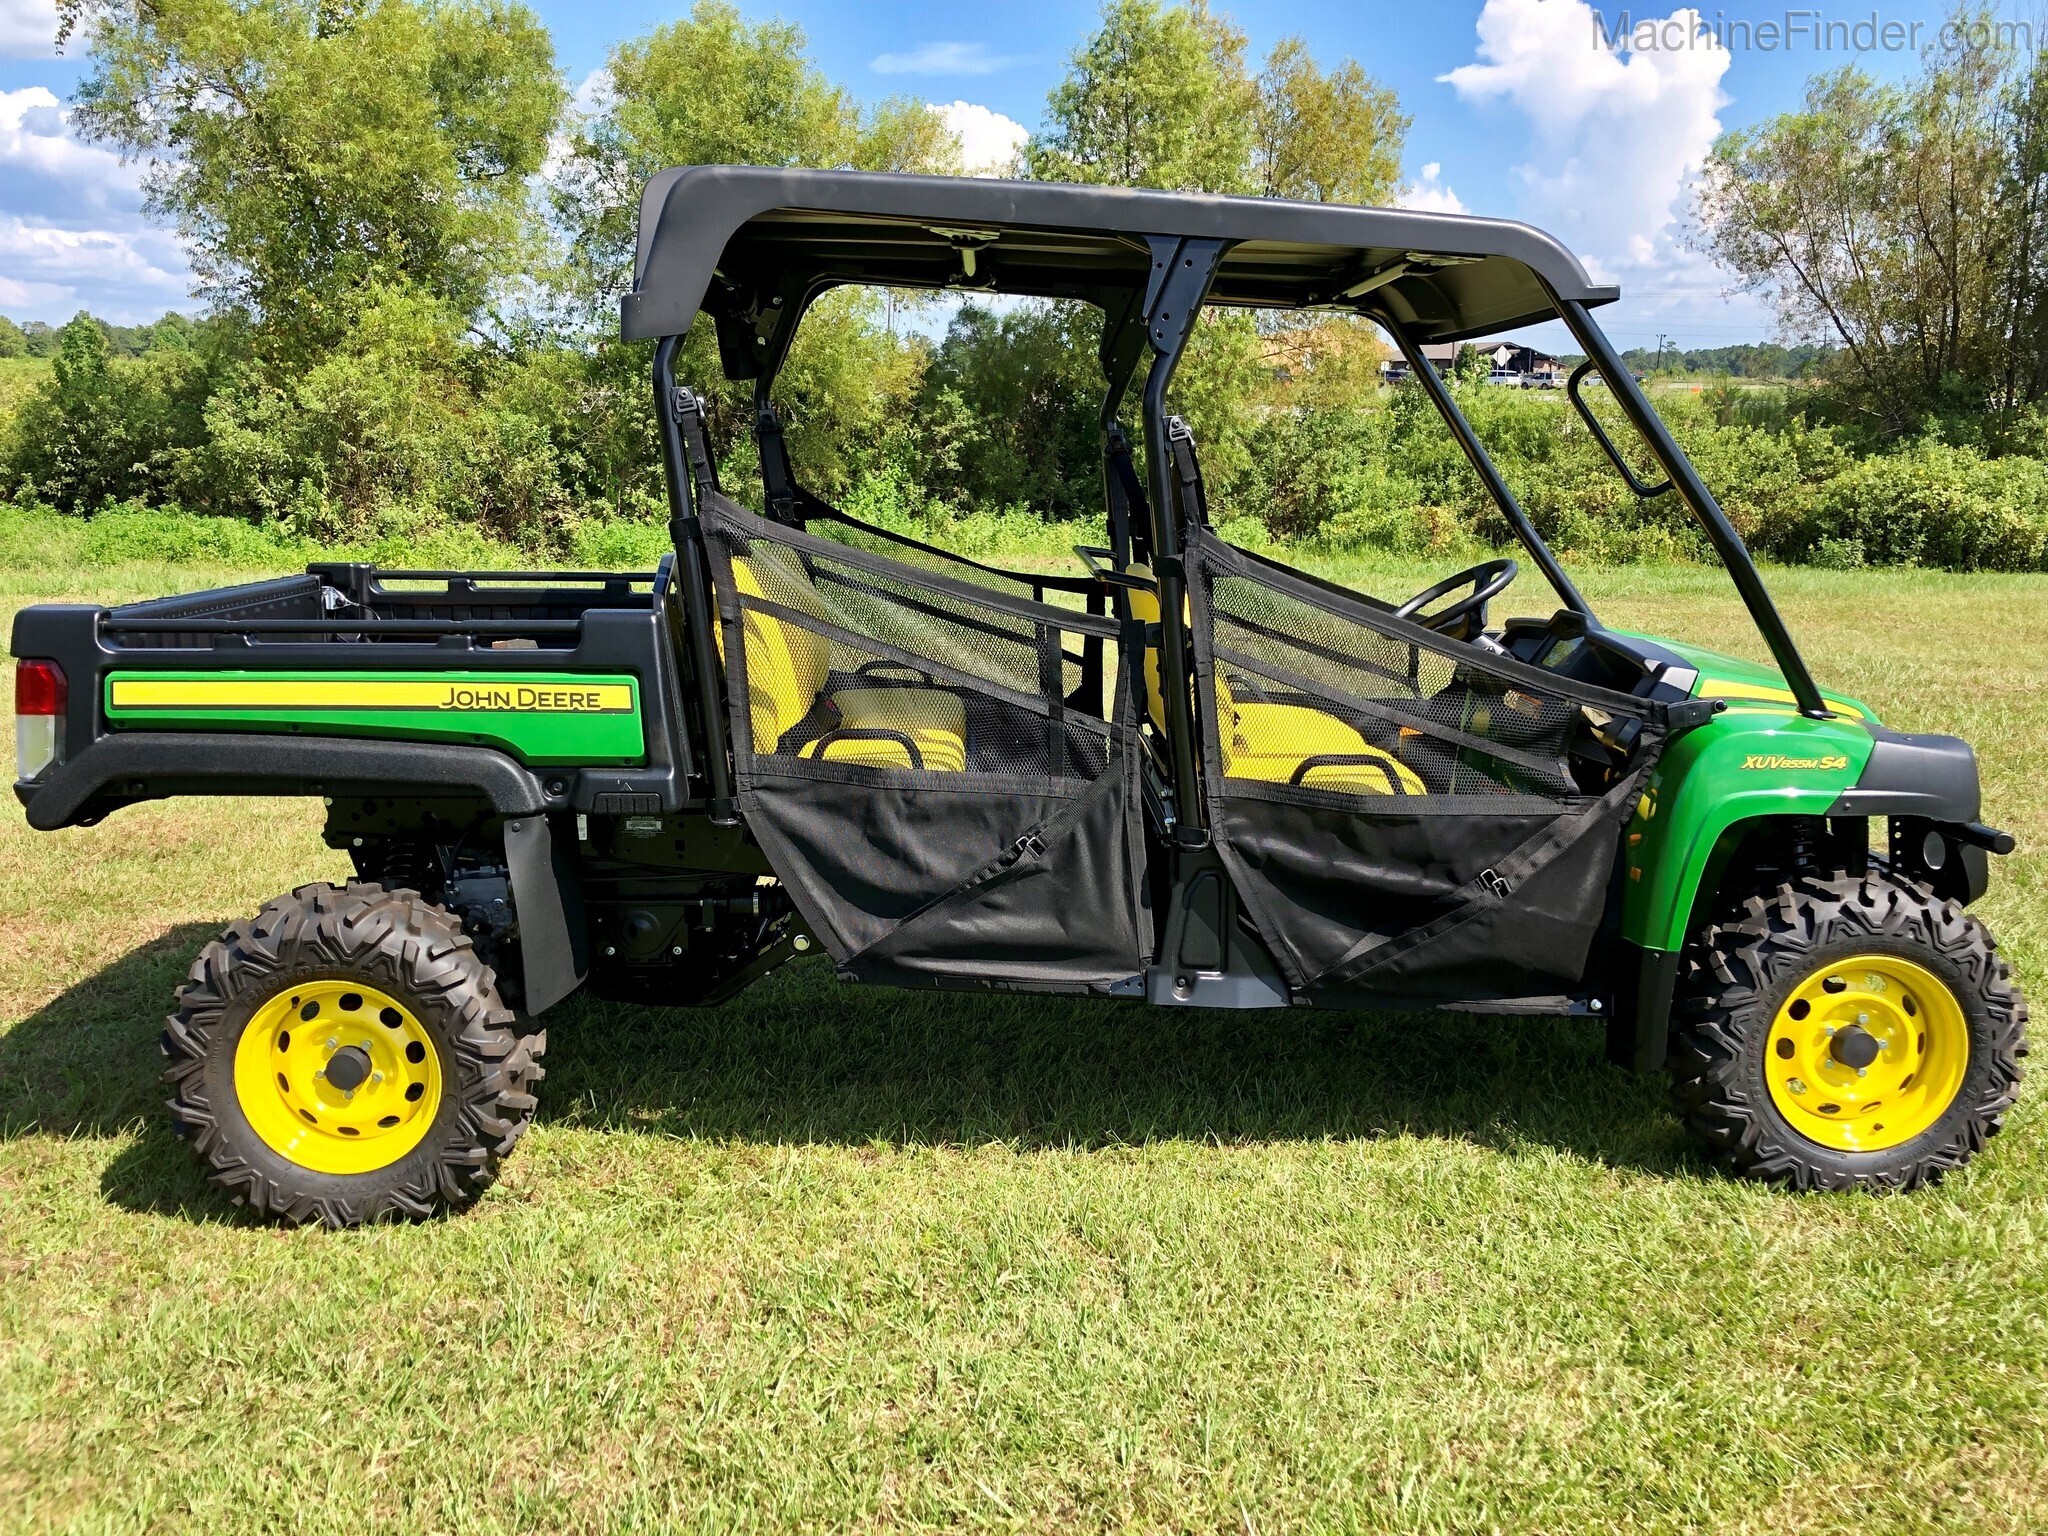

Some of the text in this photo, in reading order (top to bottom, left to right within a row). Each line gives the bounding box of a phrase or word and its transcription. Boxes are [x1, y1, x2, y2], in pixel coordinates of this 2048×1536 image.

[441, 687, 601, 709] JOHN DEERE
[1740, 755, 1847, 770] XUV855M S4
